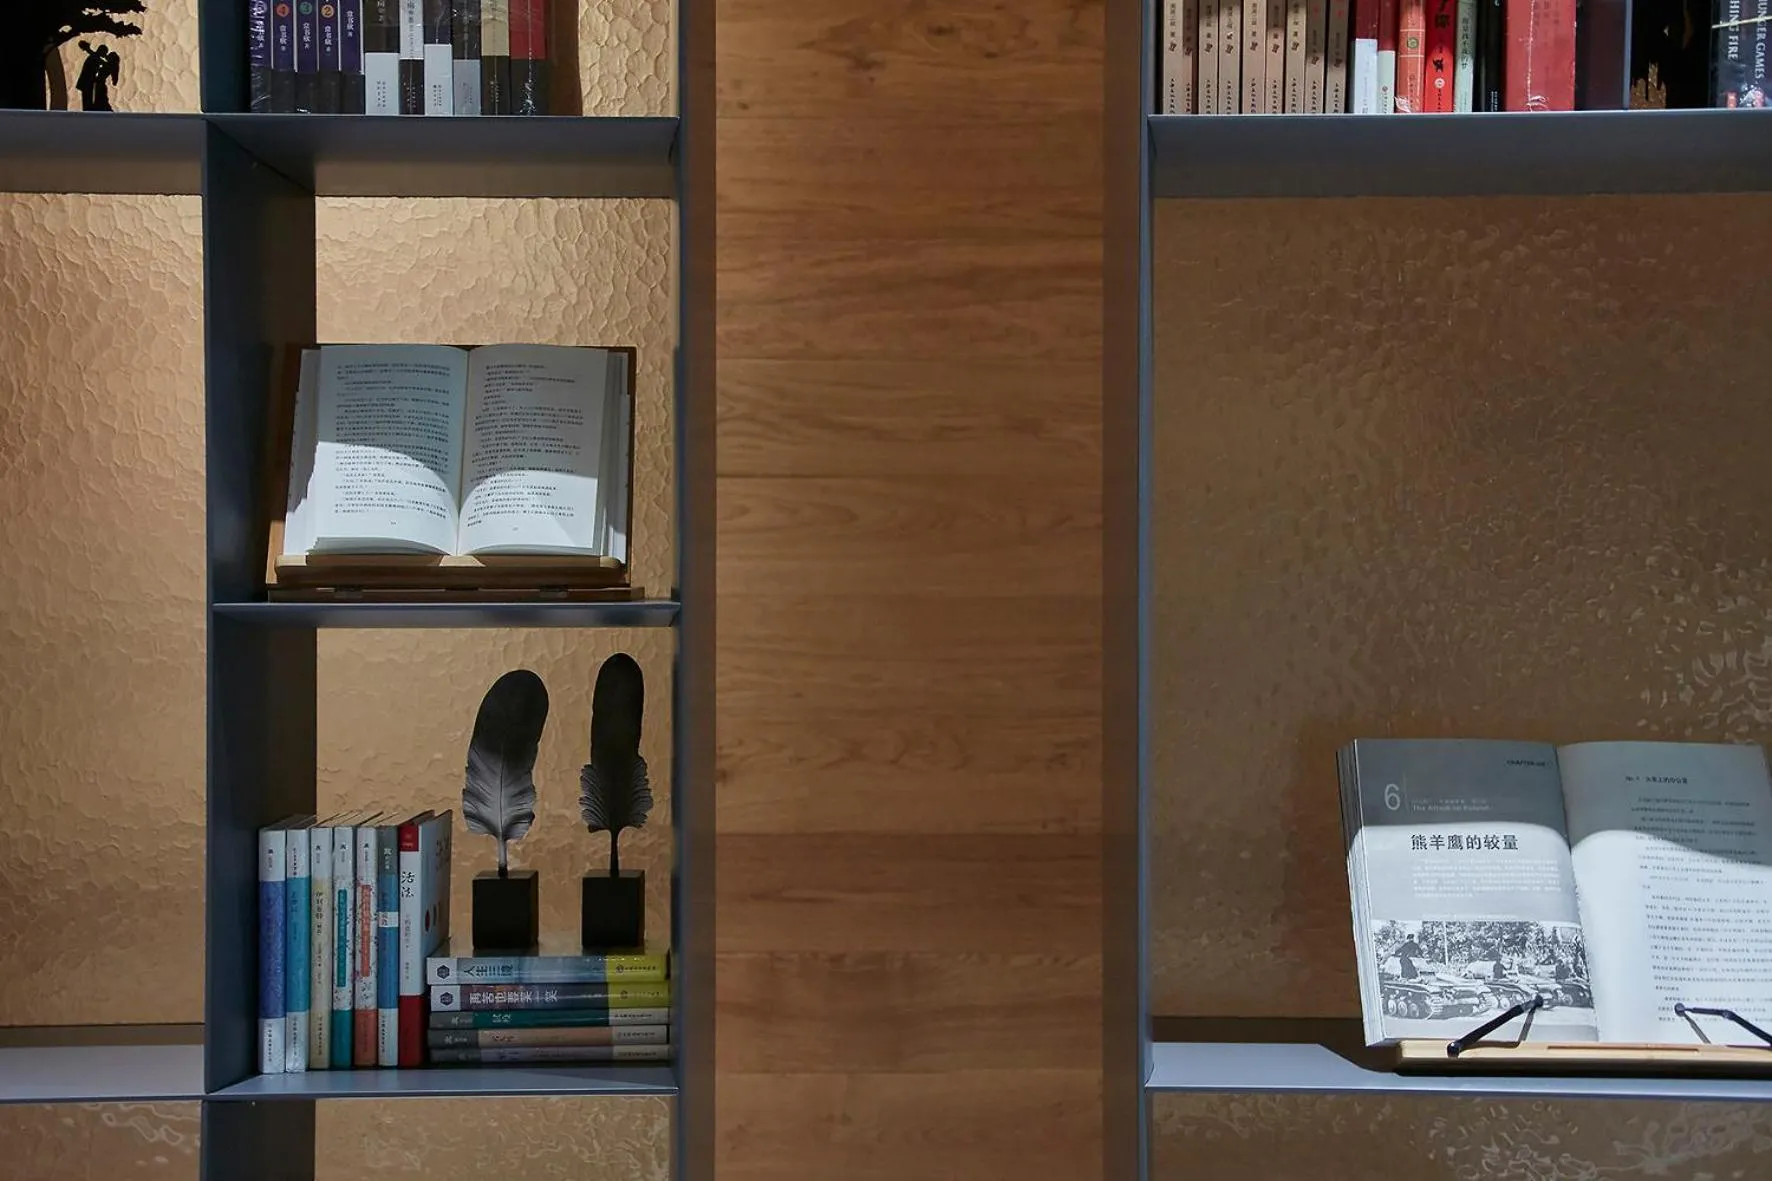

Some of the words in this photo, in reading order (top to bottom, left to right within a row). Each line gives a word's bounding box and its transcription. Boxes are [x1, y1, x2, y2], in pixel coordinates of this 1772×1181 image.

[1728, 35, 1739, 61] FIRE
[1755, 43, 1766, 79] GAMES
[1384, 783, 1401, 811] 6
[1411, 834, 1518, 851] 熊羊鹰的较量
[401, 871, 416, 898] 活法
[469, 989, 558, 1004] 再苦也要笑一笑
